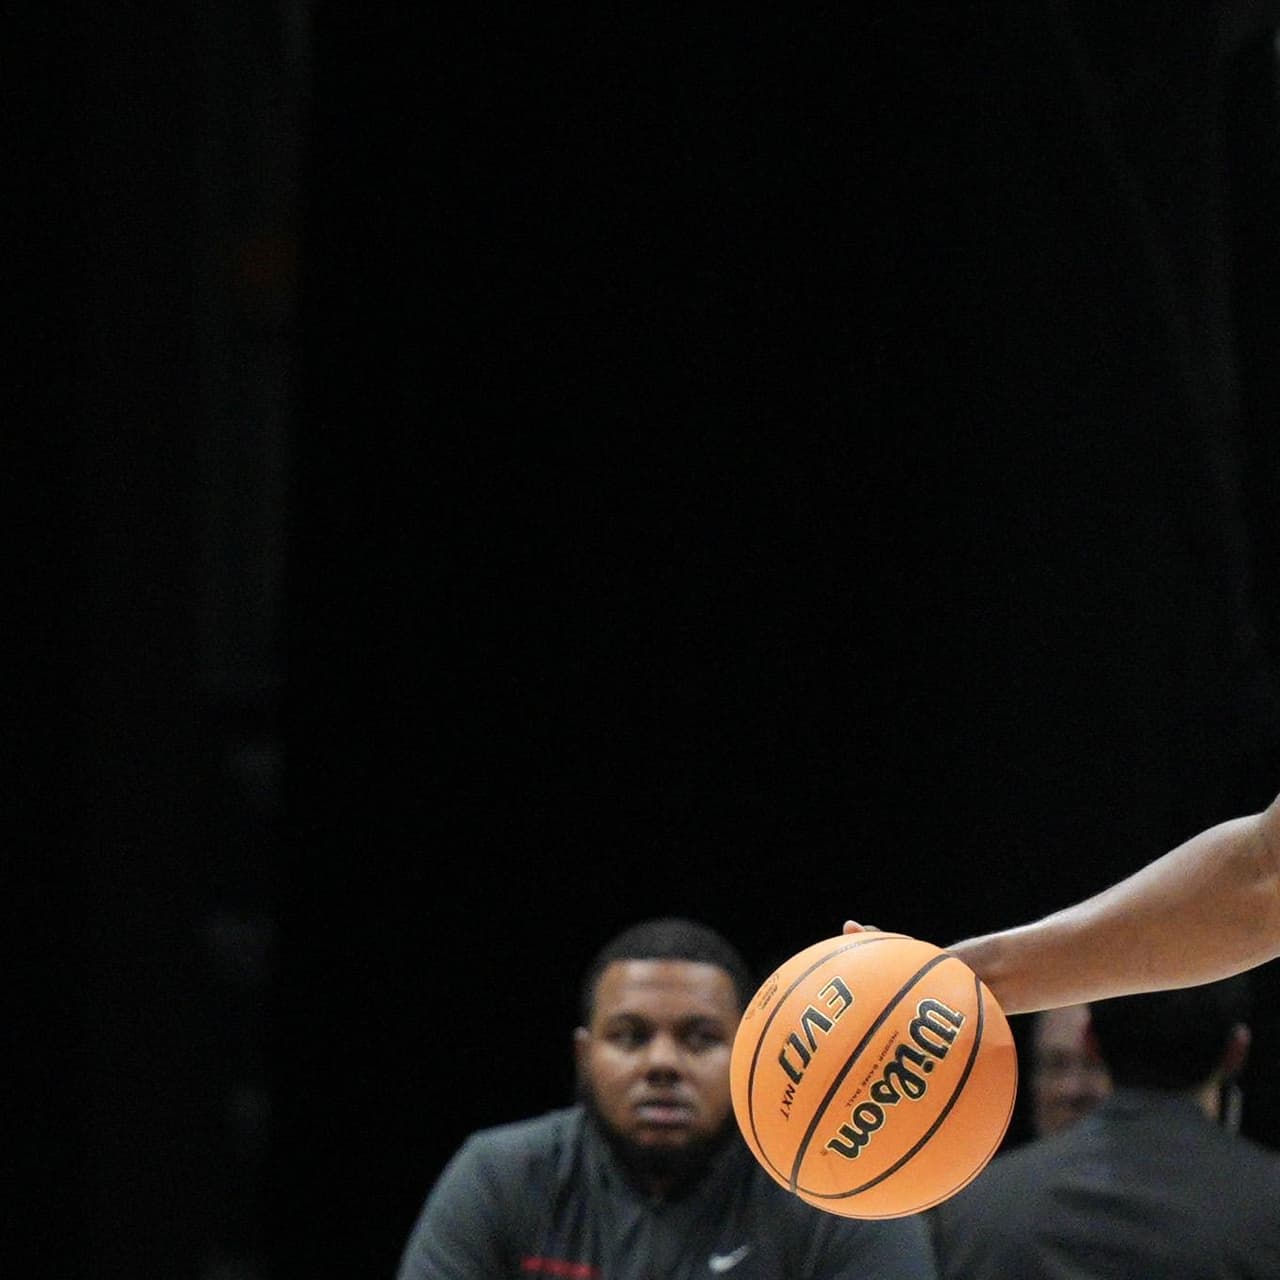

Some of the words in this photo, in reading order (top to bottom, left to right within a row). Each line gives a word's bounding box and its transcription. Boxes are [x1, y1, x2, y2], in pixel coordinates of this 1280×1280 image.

[778, 975, 855, 1086] EVO
[824, 998, 969, 1160] Wilson
[781, 1083, 797, 1121] NXT
